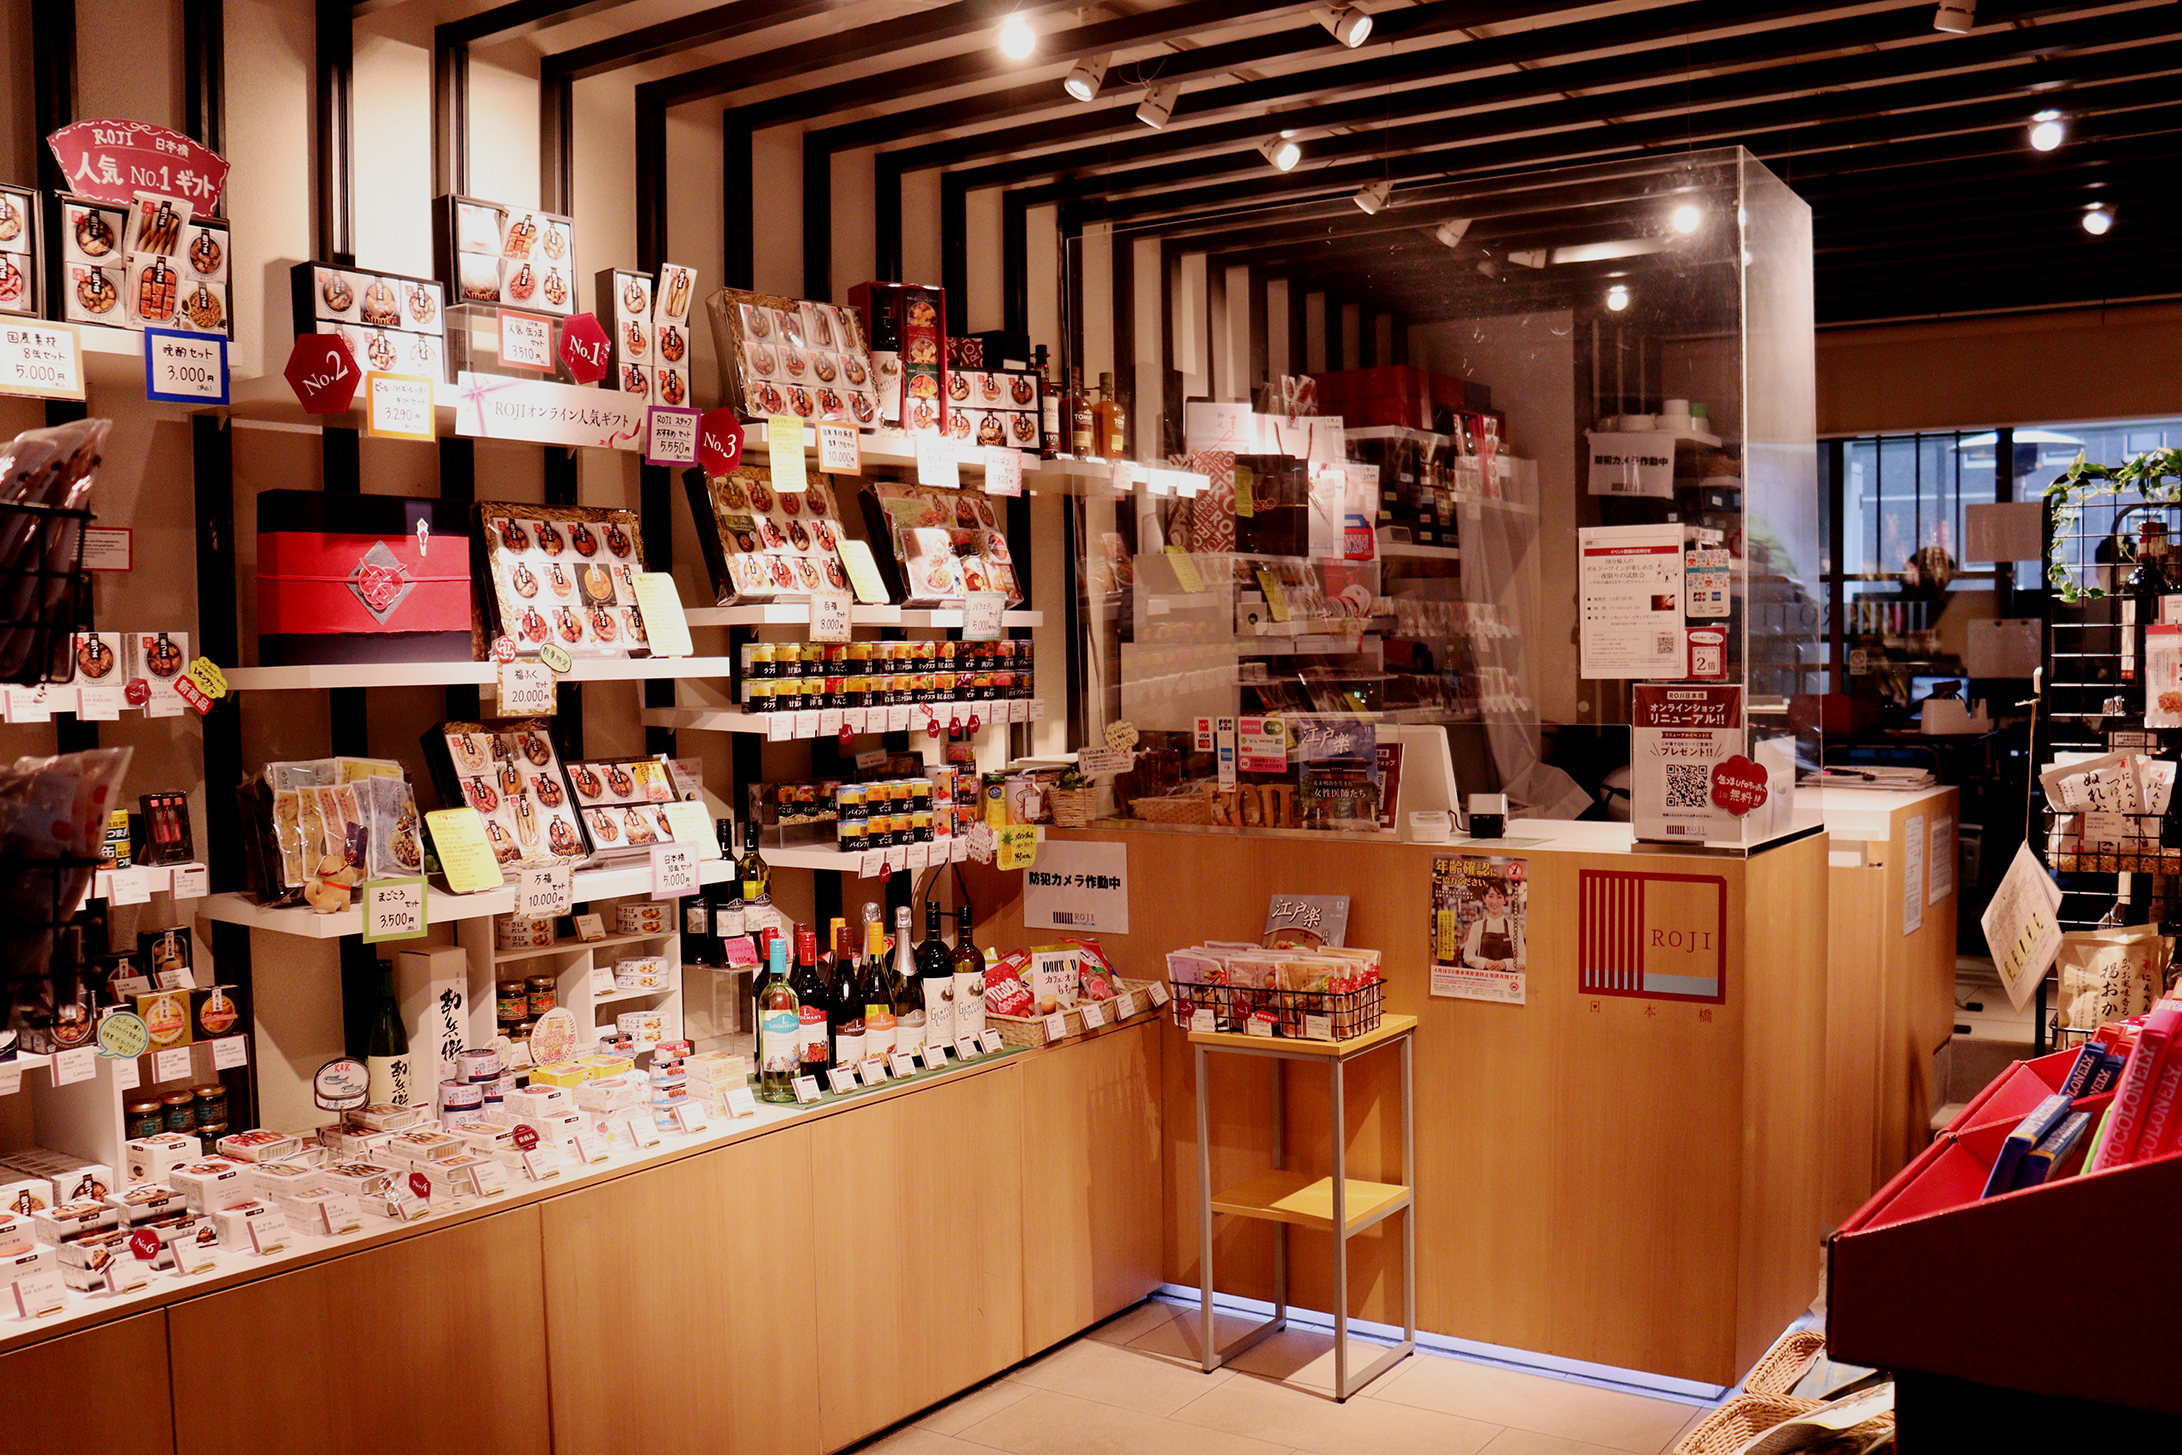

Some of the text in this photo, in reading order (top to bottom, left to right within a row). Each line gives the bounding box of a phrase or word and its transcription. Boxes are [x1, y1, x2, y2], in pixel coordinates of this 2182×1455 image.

[93, 129, 189, 158] ROJI 日本橋
[74, 152, 215, 198] 人気 No.1 ギフト
[189, 347, 213, 360] セット
[569, 335, 600, 366] No.1
[167, 366, 214, 383] 3,000円
[302, 350, 348, 396] No.2
[495, 401, 629, 427] ROJIオンライン人気ギフト
[657, 415, 671, 424] ROJI
[703, 432, 737, 458] No.3
[1594, 454, 1669, 467] 防犯カメラ作動中
[543, 646, 568, 669] 数量限定
[1697, 657, 1716, 671] 2倍
[130, 684, 146, 699] No.7
[177, 678, 210, 712] 新商品
[1650, 703, 1725, 713] オンラインショップ
[1651, 713, 1725, 724] リニューアル!!
[1301, 726, 1350, 754] 江戸楽
[1661, 747, 1713, 757] プレゼント!!
[1314, 788, 1366, 798] 女性医師たち
[2122, 772, 2137, 809] にんべん
[665, 853, 685, 864] 日本橋
[1435, 859, 1498, 877] 年齢確認に
[534, 873, 552, 885] 万福
[1028, 871, 1121, 890] 防犯カメラ作動中
[1435, 877, 1489, 888] ご協力ください。
[378, 890, 405, 902] まごころ
[529, 892, 563, 907] 10,000円
[379, 913, 414, 929] 3,500円
[1074, 912, 1094, 922] ROJI
[1272, 899, 1321, 928] 江戸楽
[1651, 929, 1711, 953] ROJI
[808, 953, 814, 962] L
[1057, 984, 1071, 995] もち
[1590, 1000, 1712, 1023] 日本橋
[440, 987, 464, 1065] 勘兵衛
[136, 1238, 154, 1254] No.6
